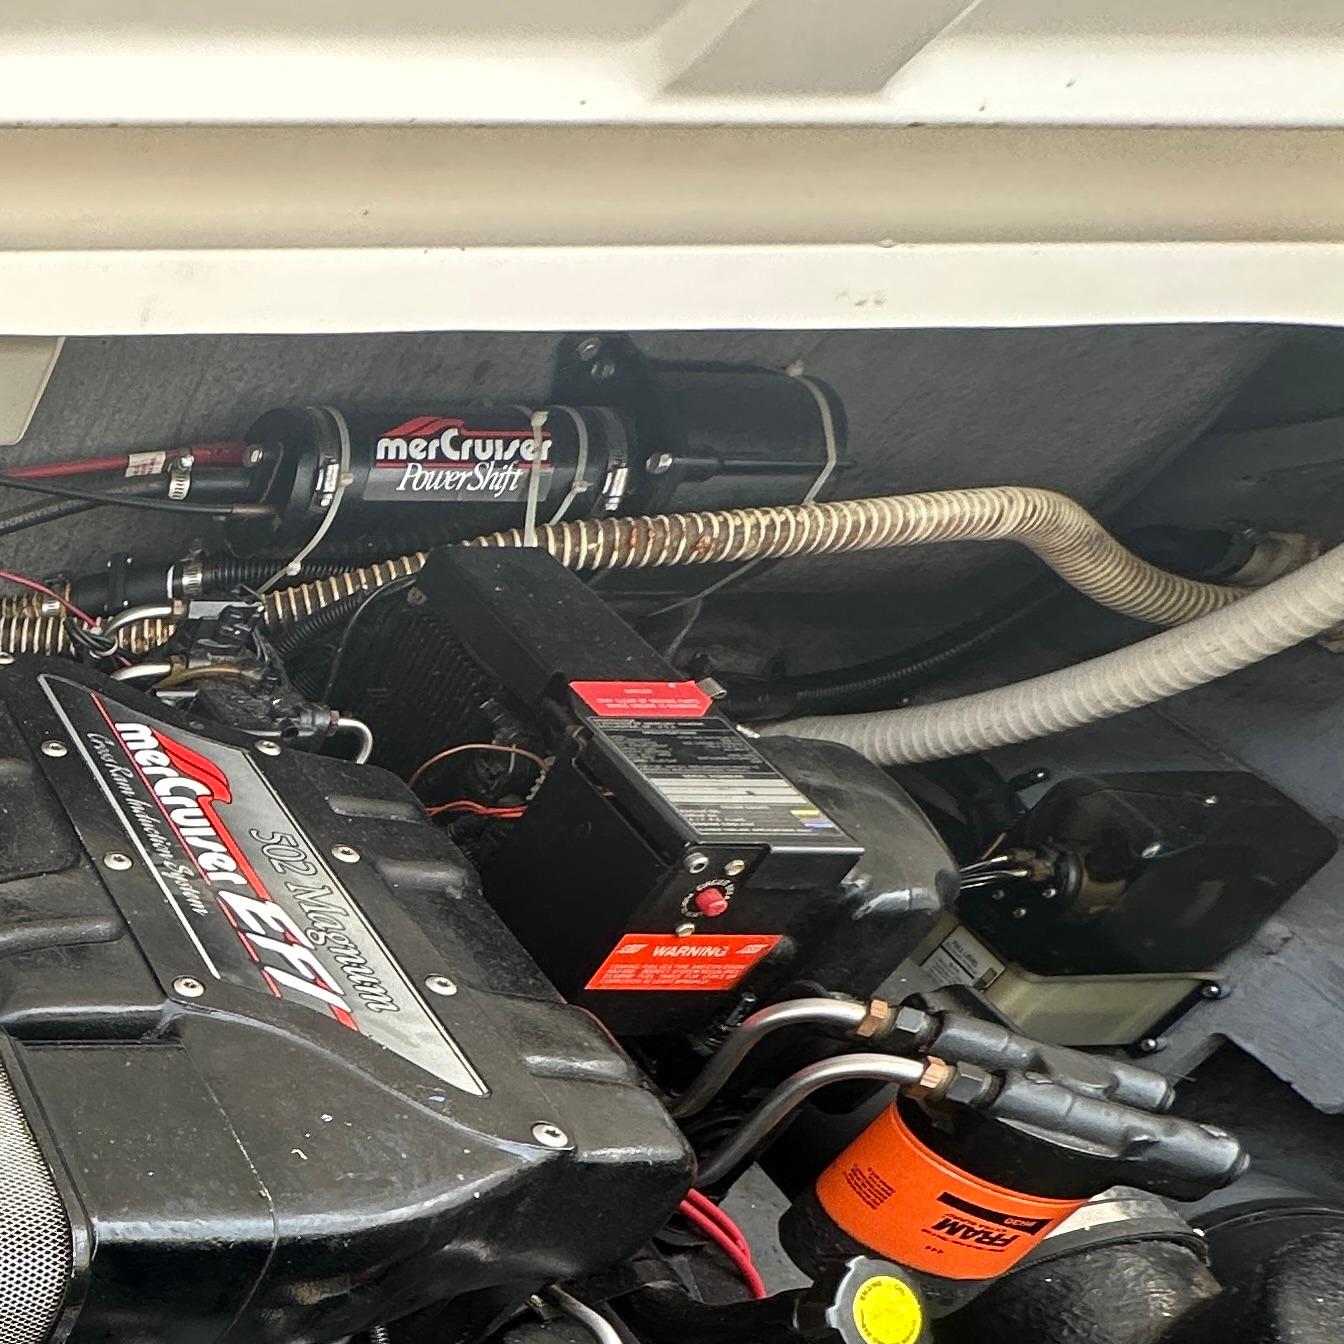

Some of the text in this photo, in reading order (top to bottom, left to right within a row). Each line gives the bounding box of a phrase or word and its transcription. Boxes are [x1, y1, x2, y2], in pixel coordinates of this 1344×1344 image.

[109, 764, 136, 798] Ram
[160, 864, 209, 917] System
[219, 889, 353, 1014] EFI
[249, 828, 401, 1014] 502 Magnum
[652, 945, 730, 958] WARNING
[931, 1216, 1021, 1250] FRAM
